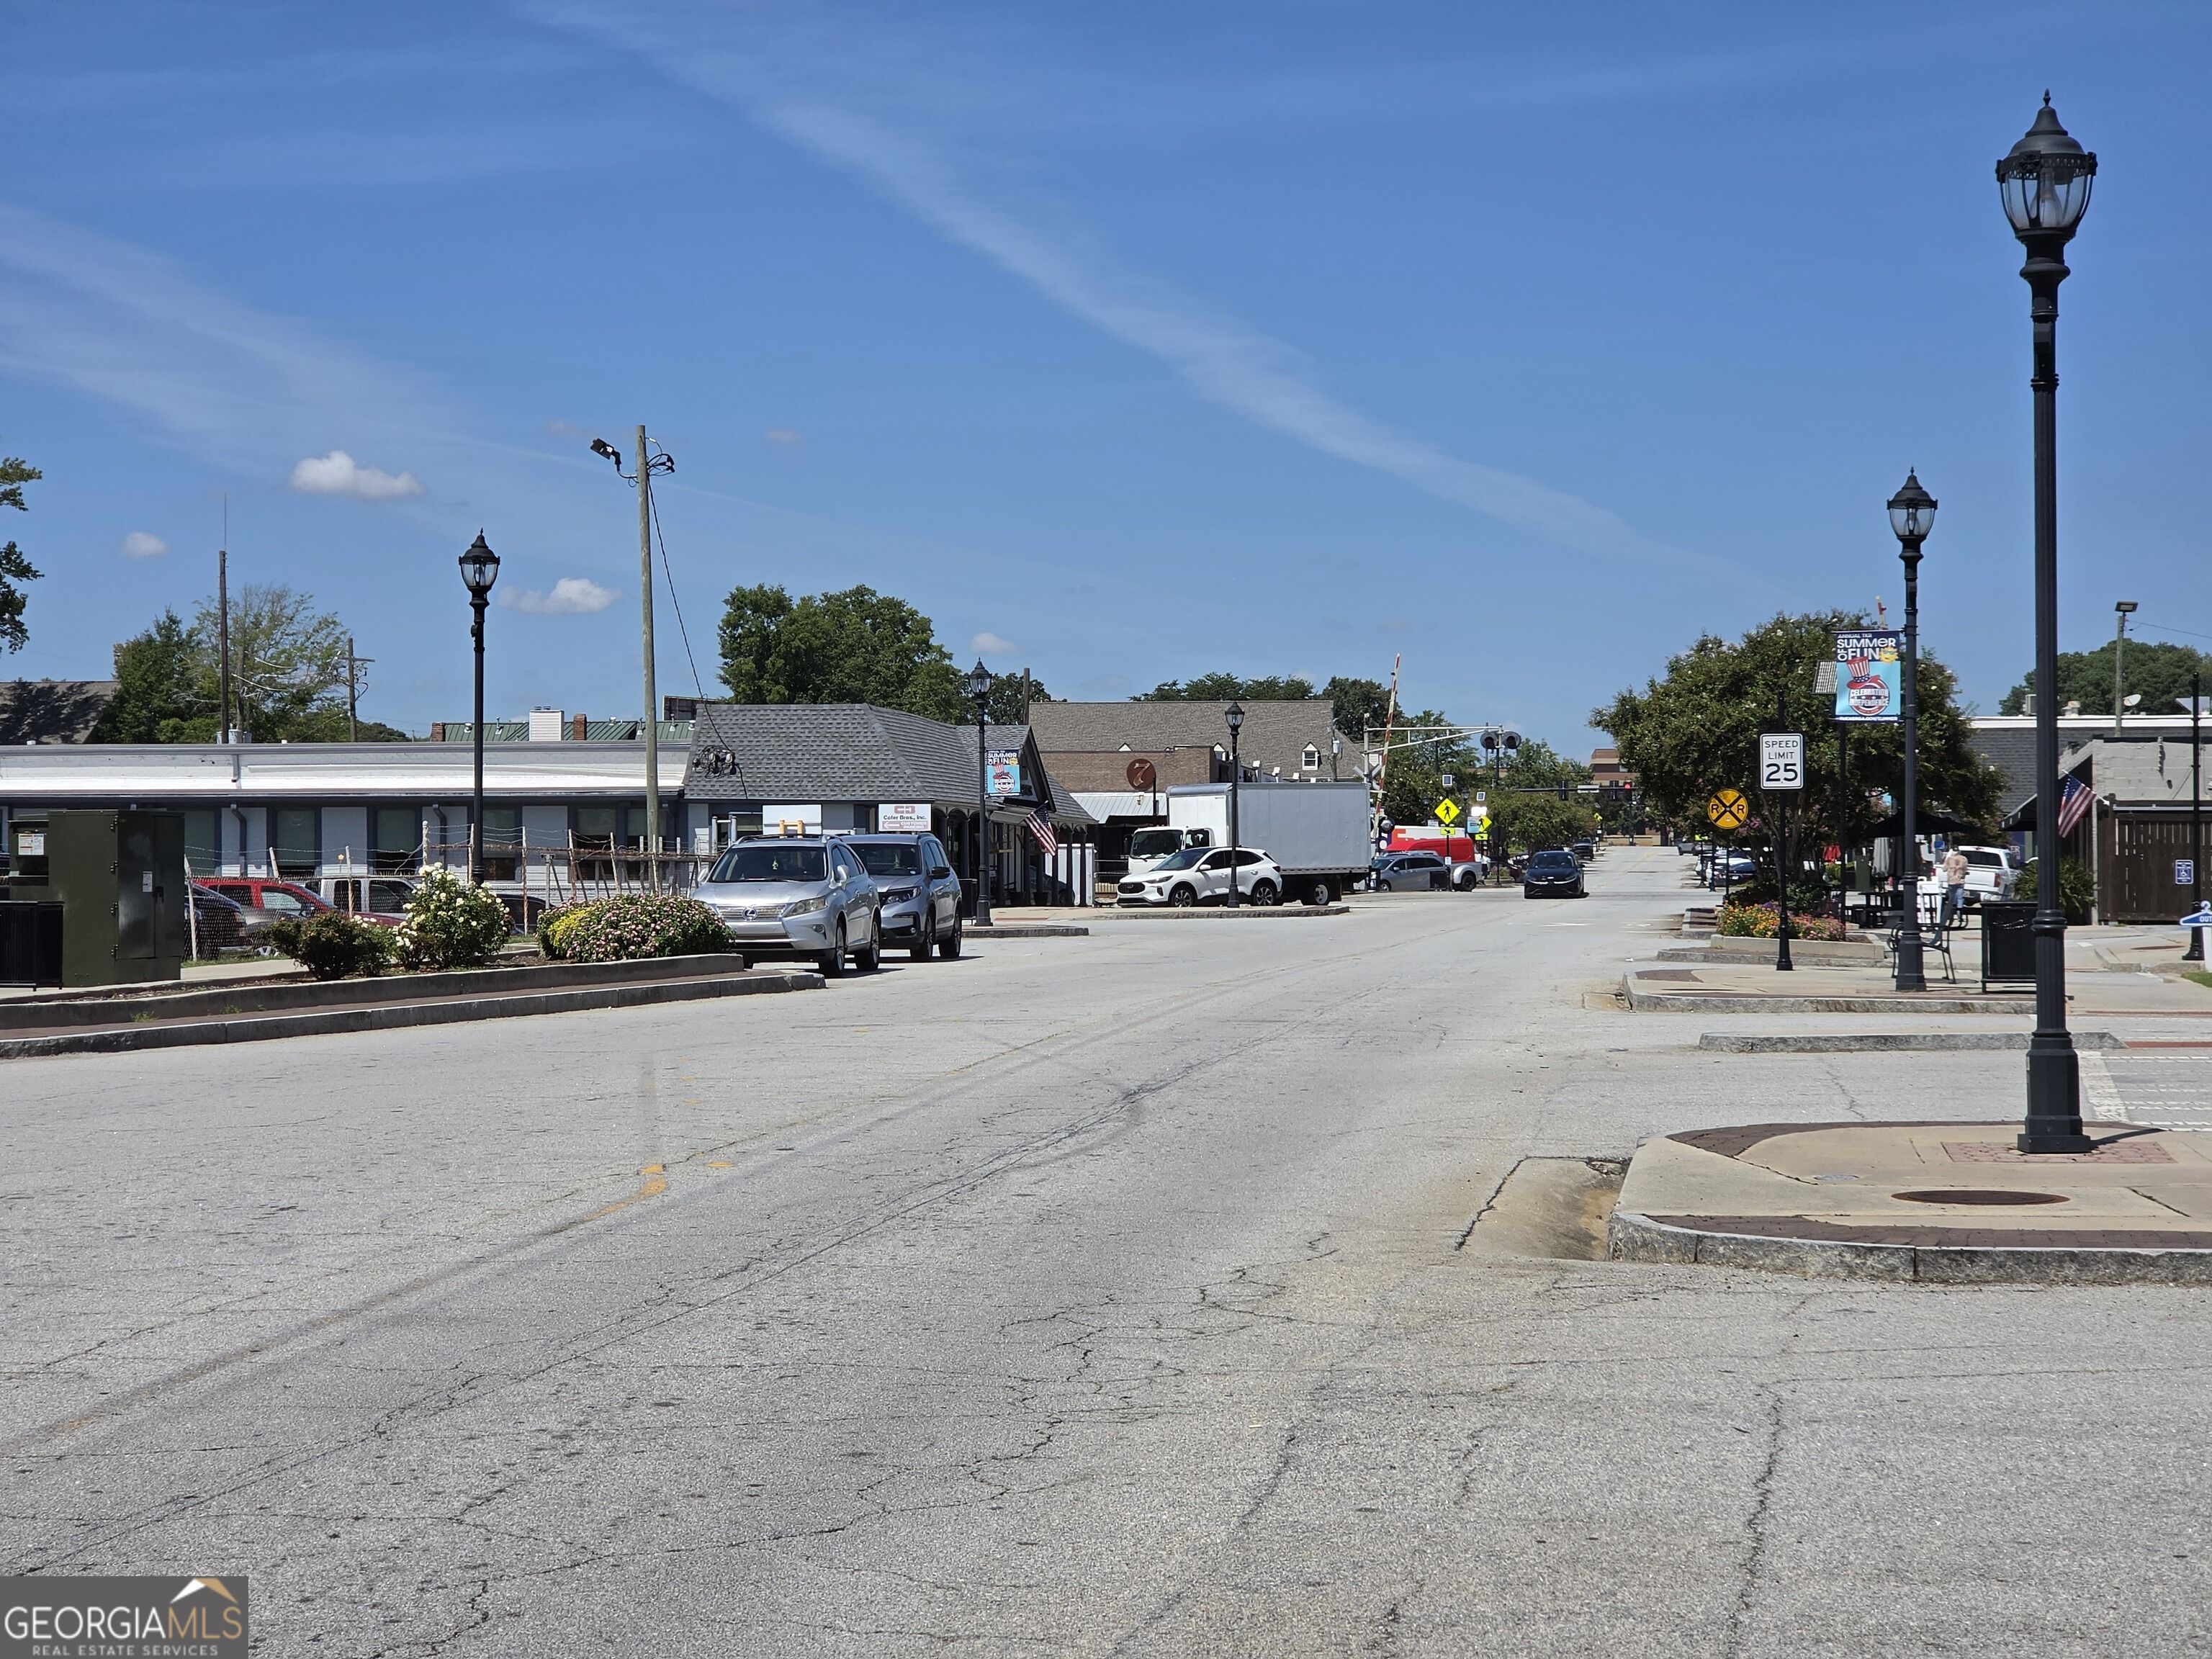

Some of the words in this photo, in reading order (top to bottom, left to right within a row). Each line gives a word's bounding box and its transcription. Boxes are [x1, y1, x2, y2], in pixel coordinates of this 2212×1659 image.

[1837, 638, 1897, 648] SUMMER
[1837, 649, 1847, 661] OF
[1848, 648, 1880, 660] FUN
[1764, 739, 1799, 748] SPEED
[1768, 751, 1795, 760] LIMIT
[1133, 763, 1151, 786] 7
[1765, 763, 1798, 782] 25
[1711, 804, 1719, 814] R
[1737, 804, 1745, 814] R
